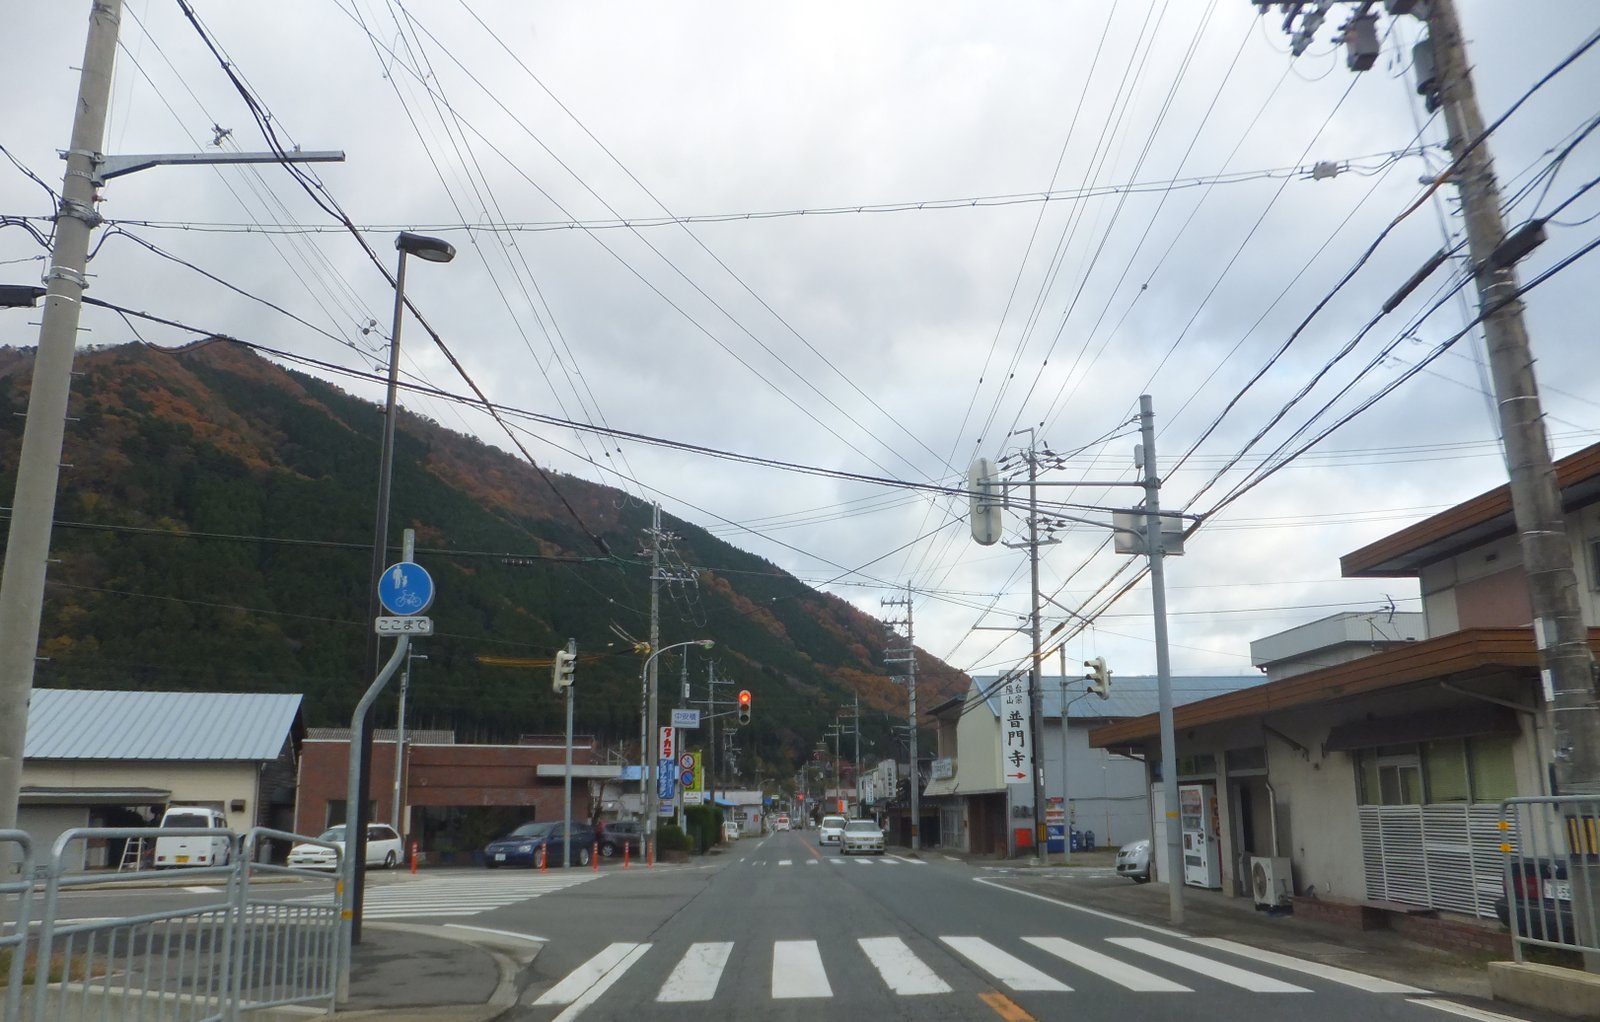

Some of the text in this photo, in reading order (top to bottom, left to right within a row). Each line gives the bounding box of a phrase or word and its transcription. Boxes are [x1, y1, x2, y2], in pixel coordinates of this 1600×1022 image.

[379, 619, 427, 631] ここまで
[663, 727, 672, 758] タカラ
[1007, 710, 1025, 768] 普門寺
